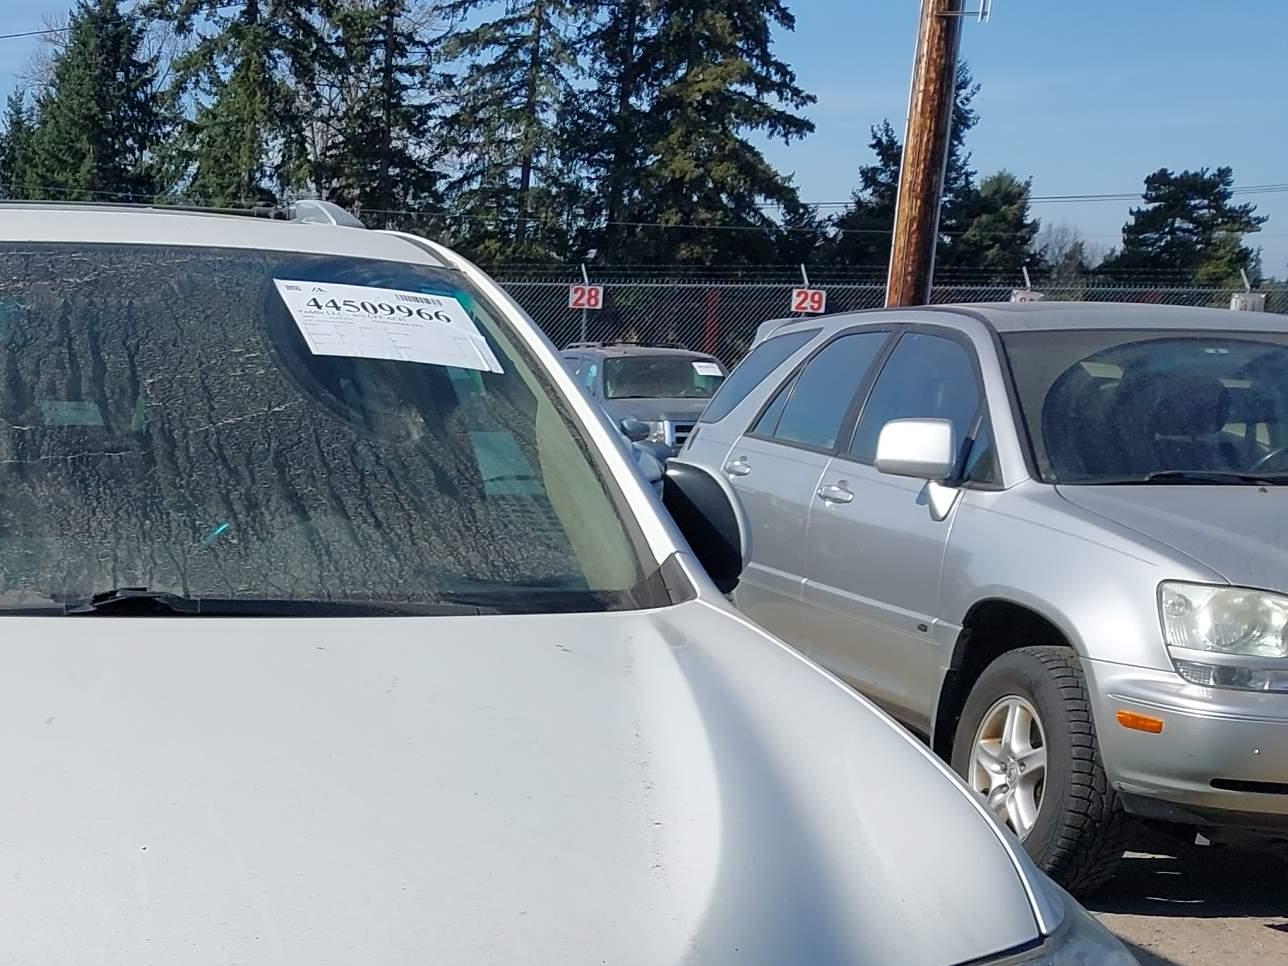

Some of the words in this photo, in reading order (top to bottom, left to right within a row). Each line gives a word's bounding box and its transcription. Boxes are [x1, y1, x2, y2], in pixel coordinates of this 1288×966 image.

[572, 286, 600, 307] 28
[794, 290, 823, 311] 29
[306, 297, 452, 324] 44509966
